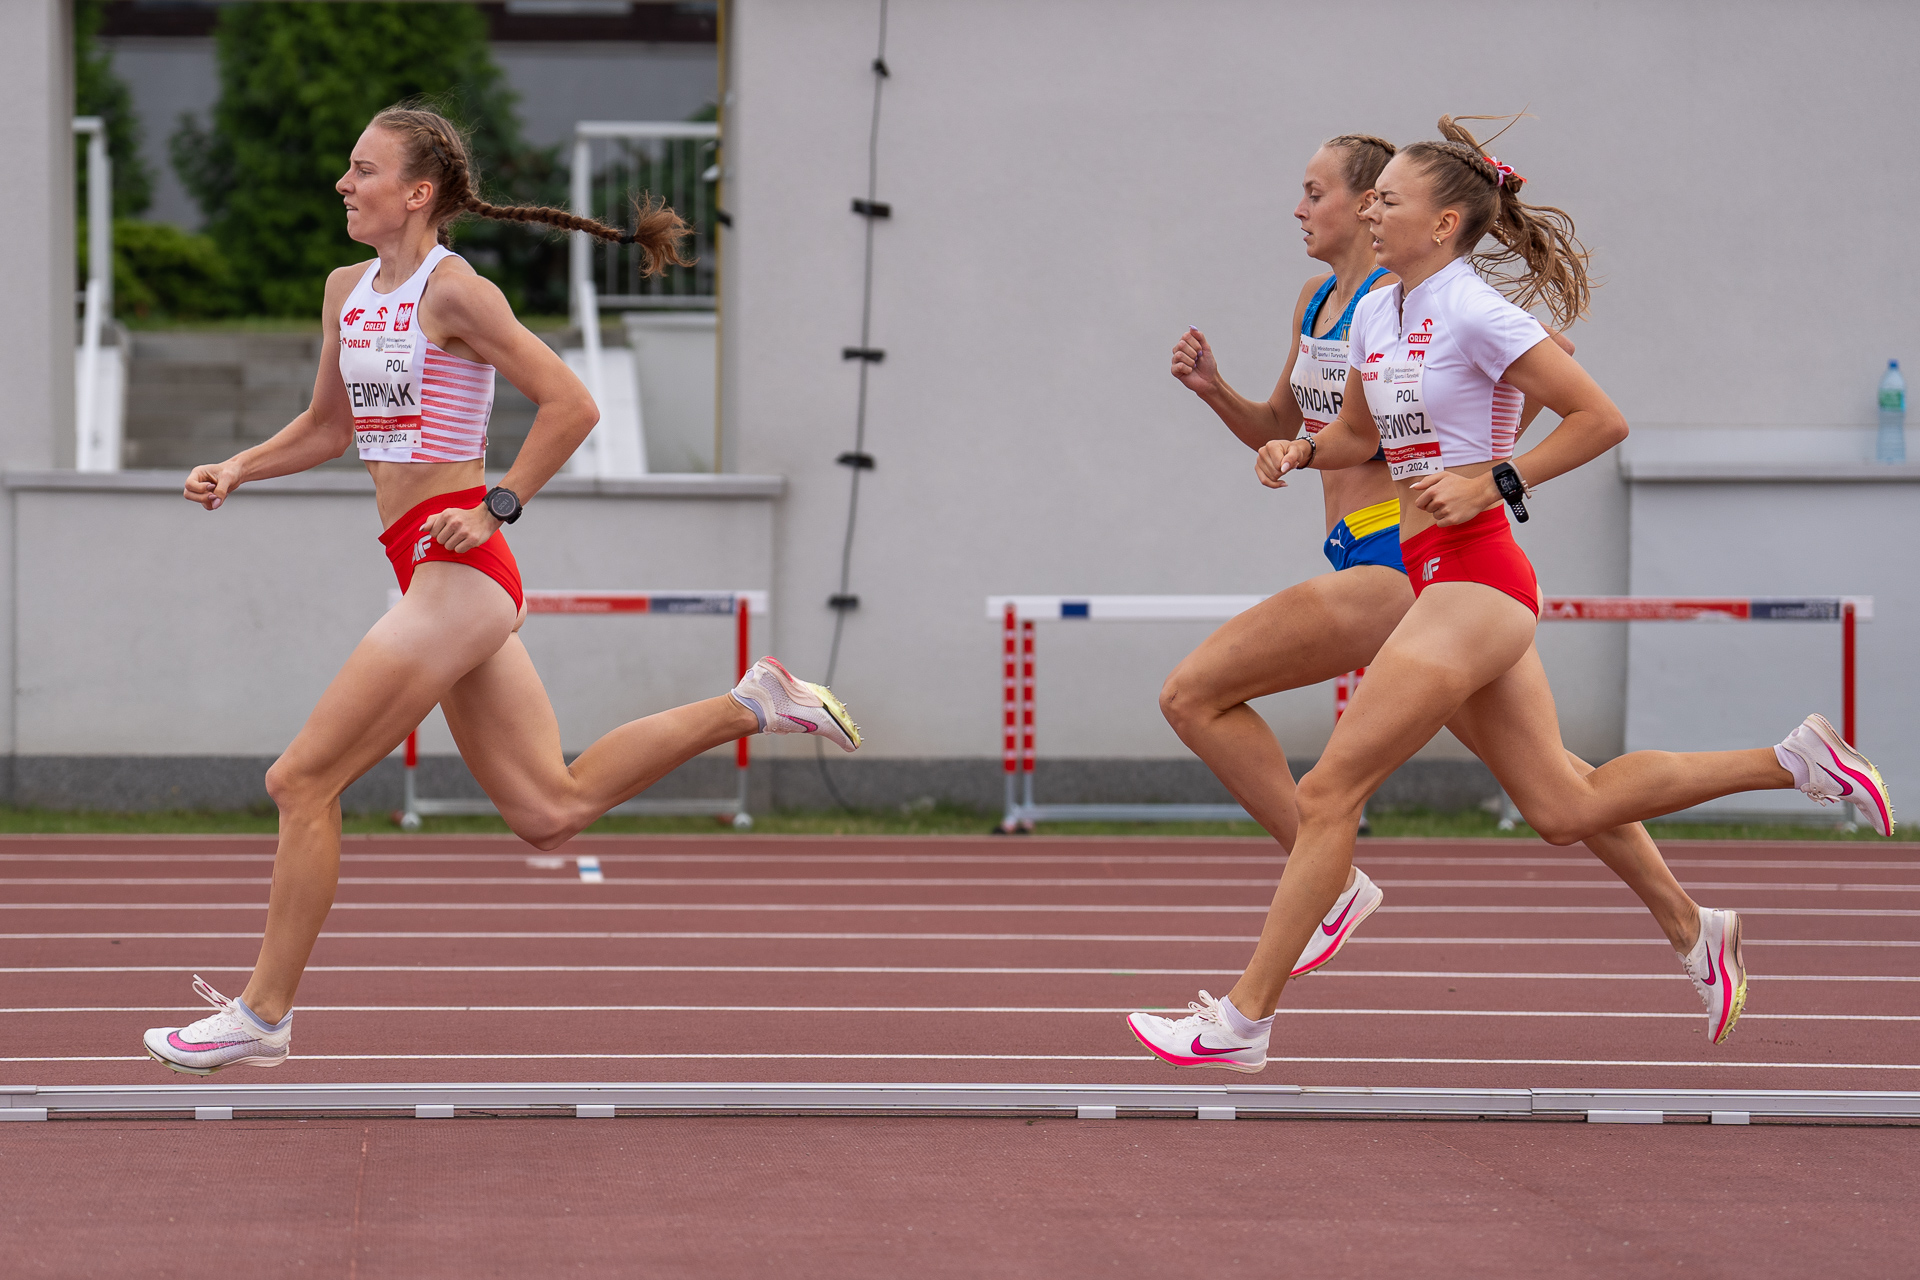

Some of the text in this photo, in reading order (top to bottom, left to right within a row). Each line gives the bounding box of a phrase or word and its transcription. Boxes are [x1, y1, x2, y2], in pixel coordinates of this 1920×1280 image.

[343, 307, 366, 326] 4F
[364, 322, 386, 331] ORLEN
[347, 339, 371, 348] ORLEN
[1408, 335, 1431, 343] ORLEN
[385, 359, 409, 373] POL
[1321, 367, 1346, 381] UKR
[1396, 389, 1419, 403] POL
